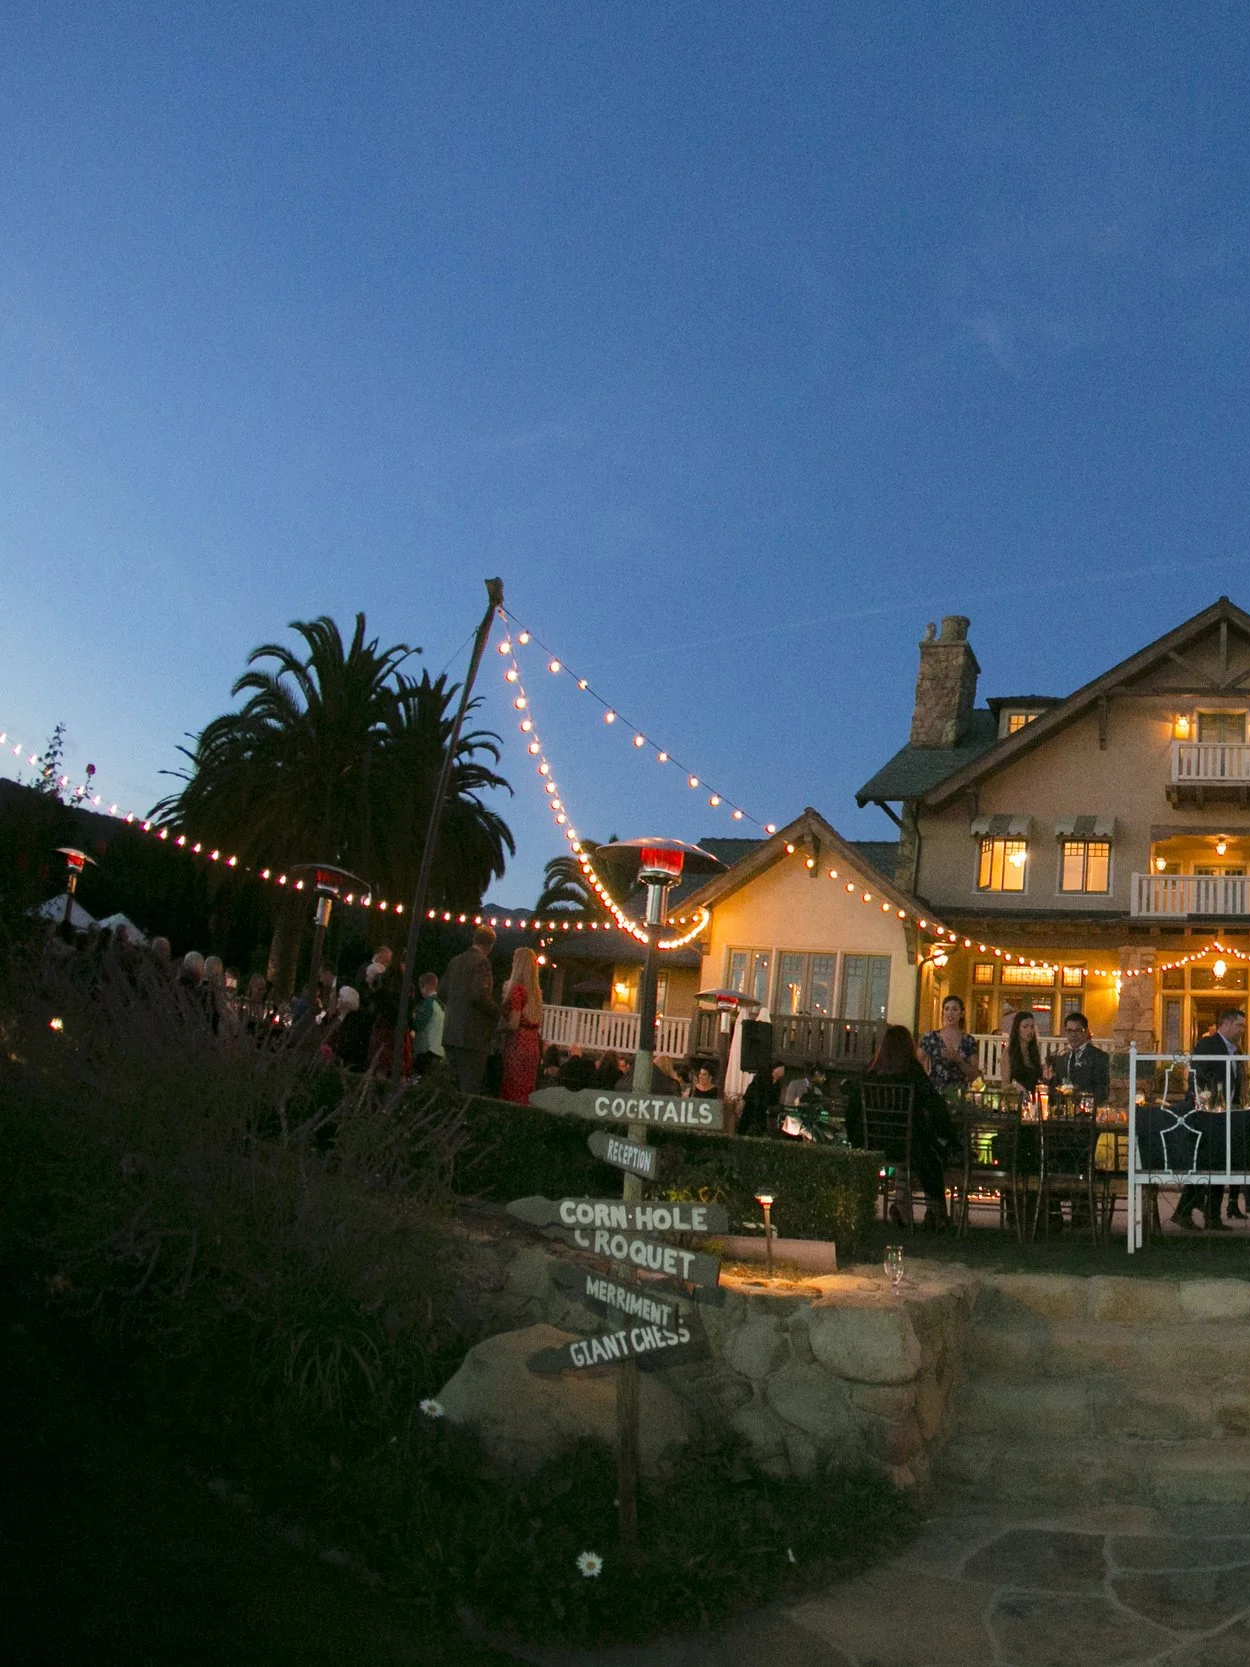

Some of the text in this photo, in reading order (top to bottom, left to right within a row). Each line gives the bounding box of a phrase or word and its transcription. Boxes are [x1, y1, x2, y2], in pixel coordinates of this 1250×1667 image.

[594, 1097, 713, 1125] COCKTAILS
[606, 1139, 652, 1173] RECEPTION
[559, 1201, 708, 1231] CORN HOLE
[586, 1275, 672, 1327] MERRIMENT
[569, 1331, 629, 1367] GIANT
